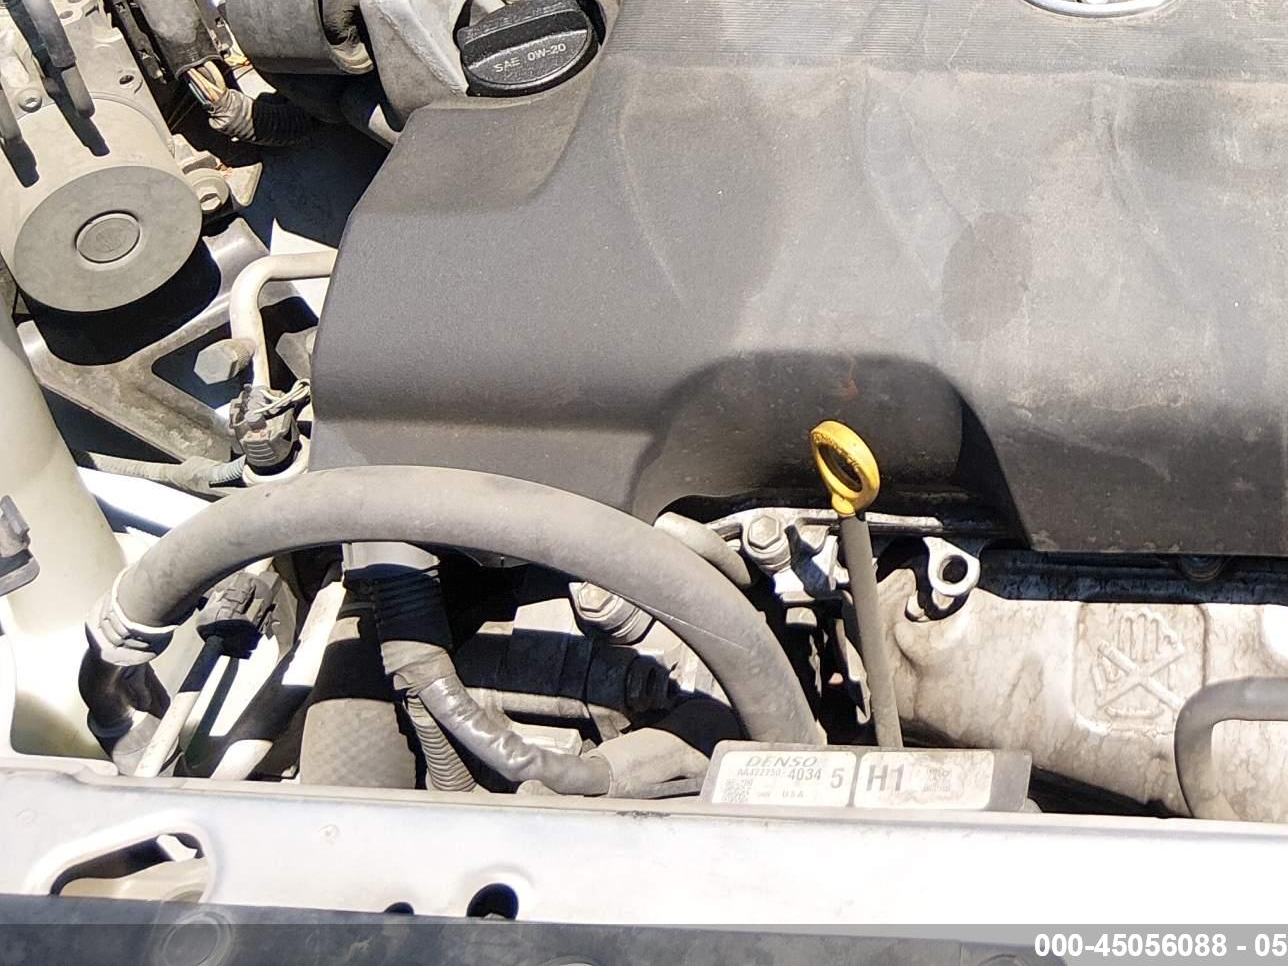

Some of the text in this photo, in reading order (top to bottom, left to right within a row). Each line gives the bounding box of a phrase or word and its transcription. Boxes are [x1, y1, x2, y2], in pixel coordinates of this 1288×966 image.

[494, 43, 567, 73] SAE 0W-20
[745, 756, 818, 767] DENSO
[830, 767, 845, 789] 5
[866, 763, 905, 792] H1
